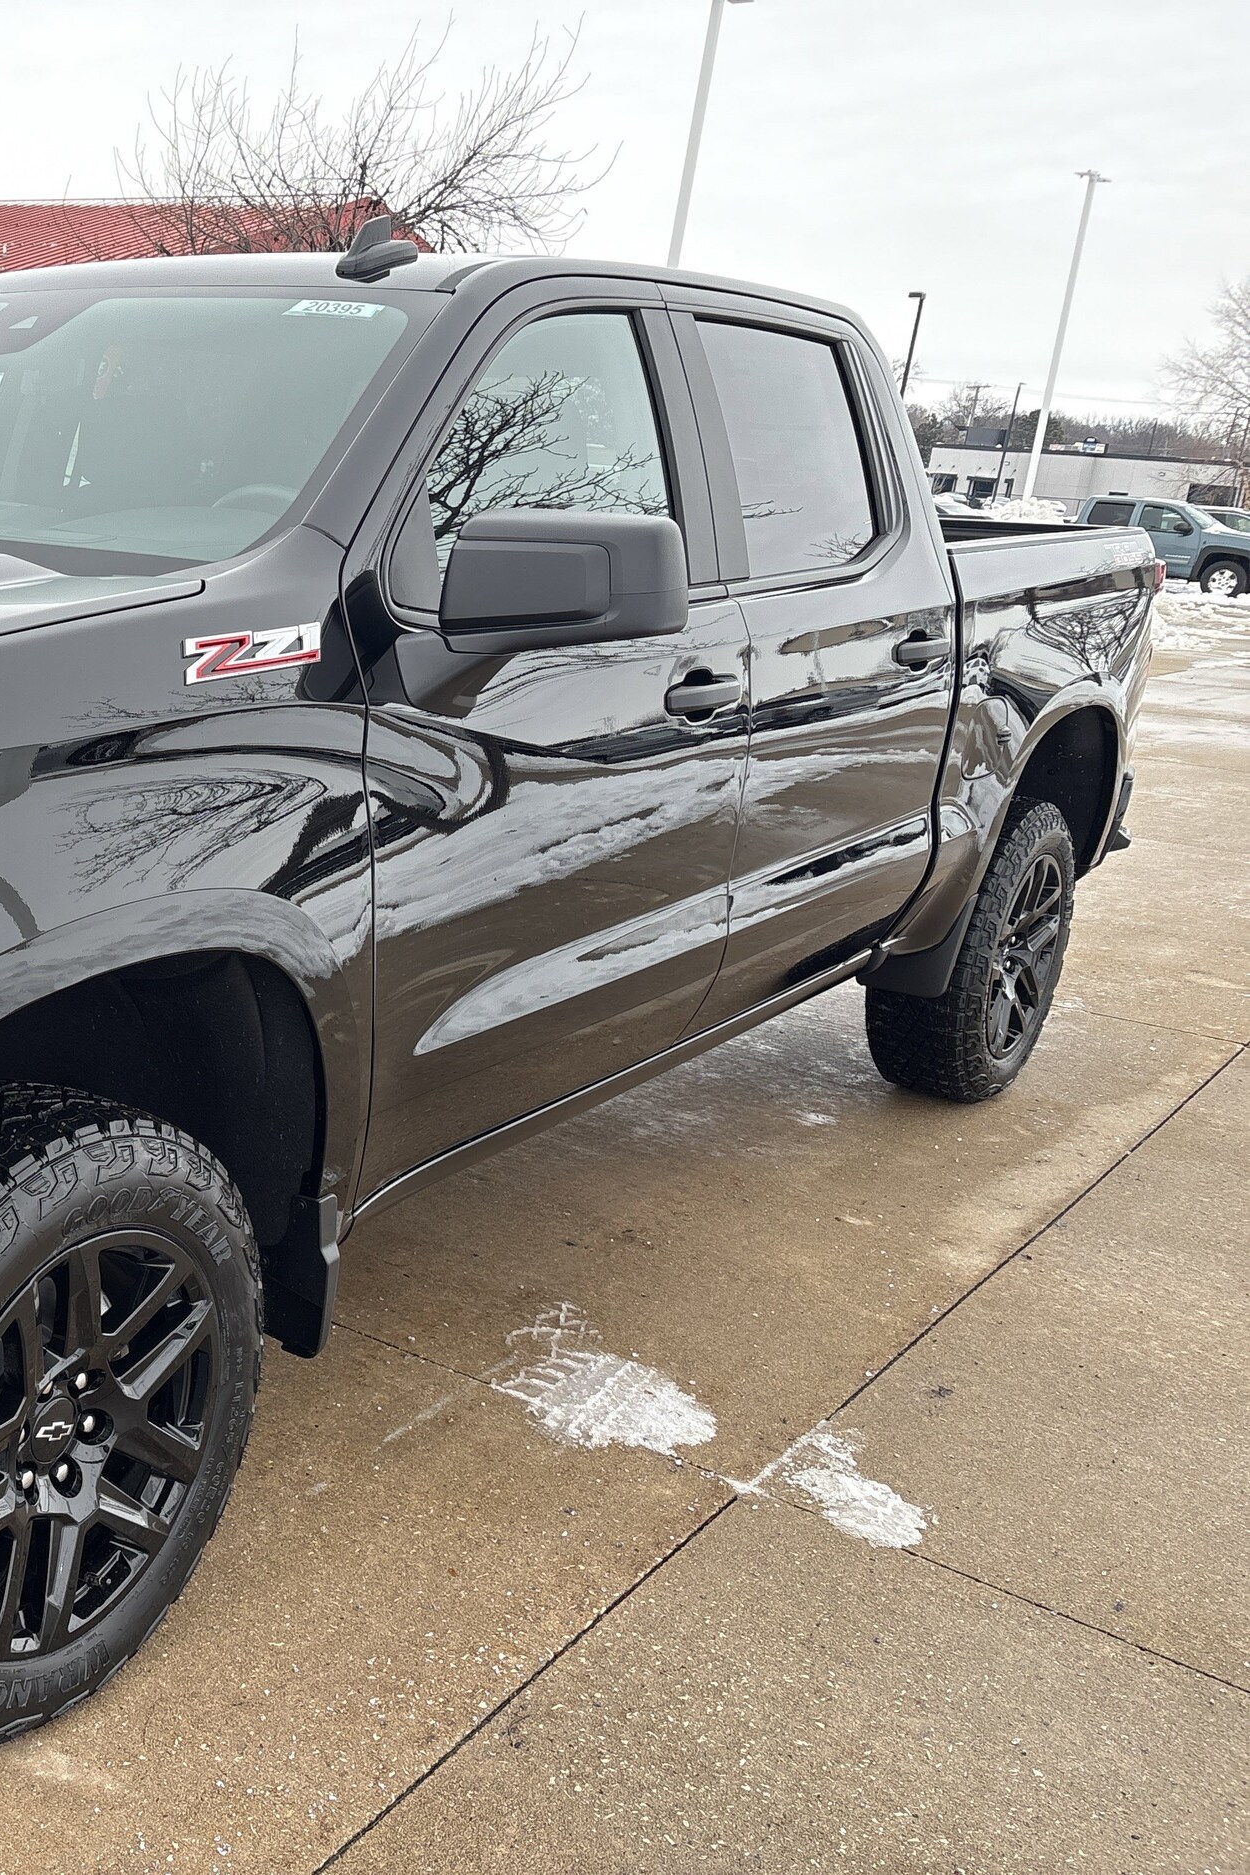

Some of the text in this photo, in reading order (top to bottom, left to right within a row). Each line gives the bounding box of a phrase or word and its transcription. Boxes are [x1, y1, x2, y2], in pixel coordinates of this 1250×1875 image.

[303, 301, 366, 315] 20395
[181, 622, 321, 686] Z71
[62, 1187, 233, 1266] GOODYEAR
